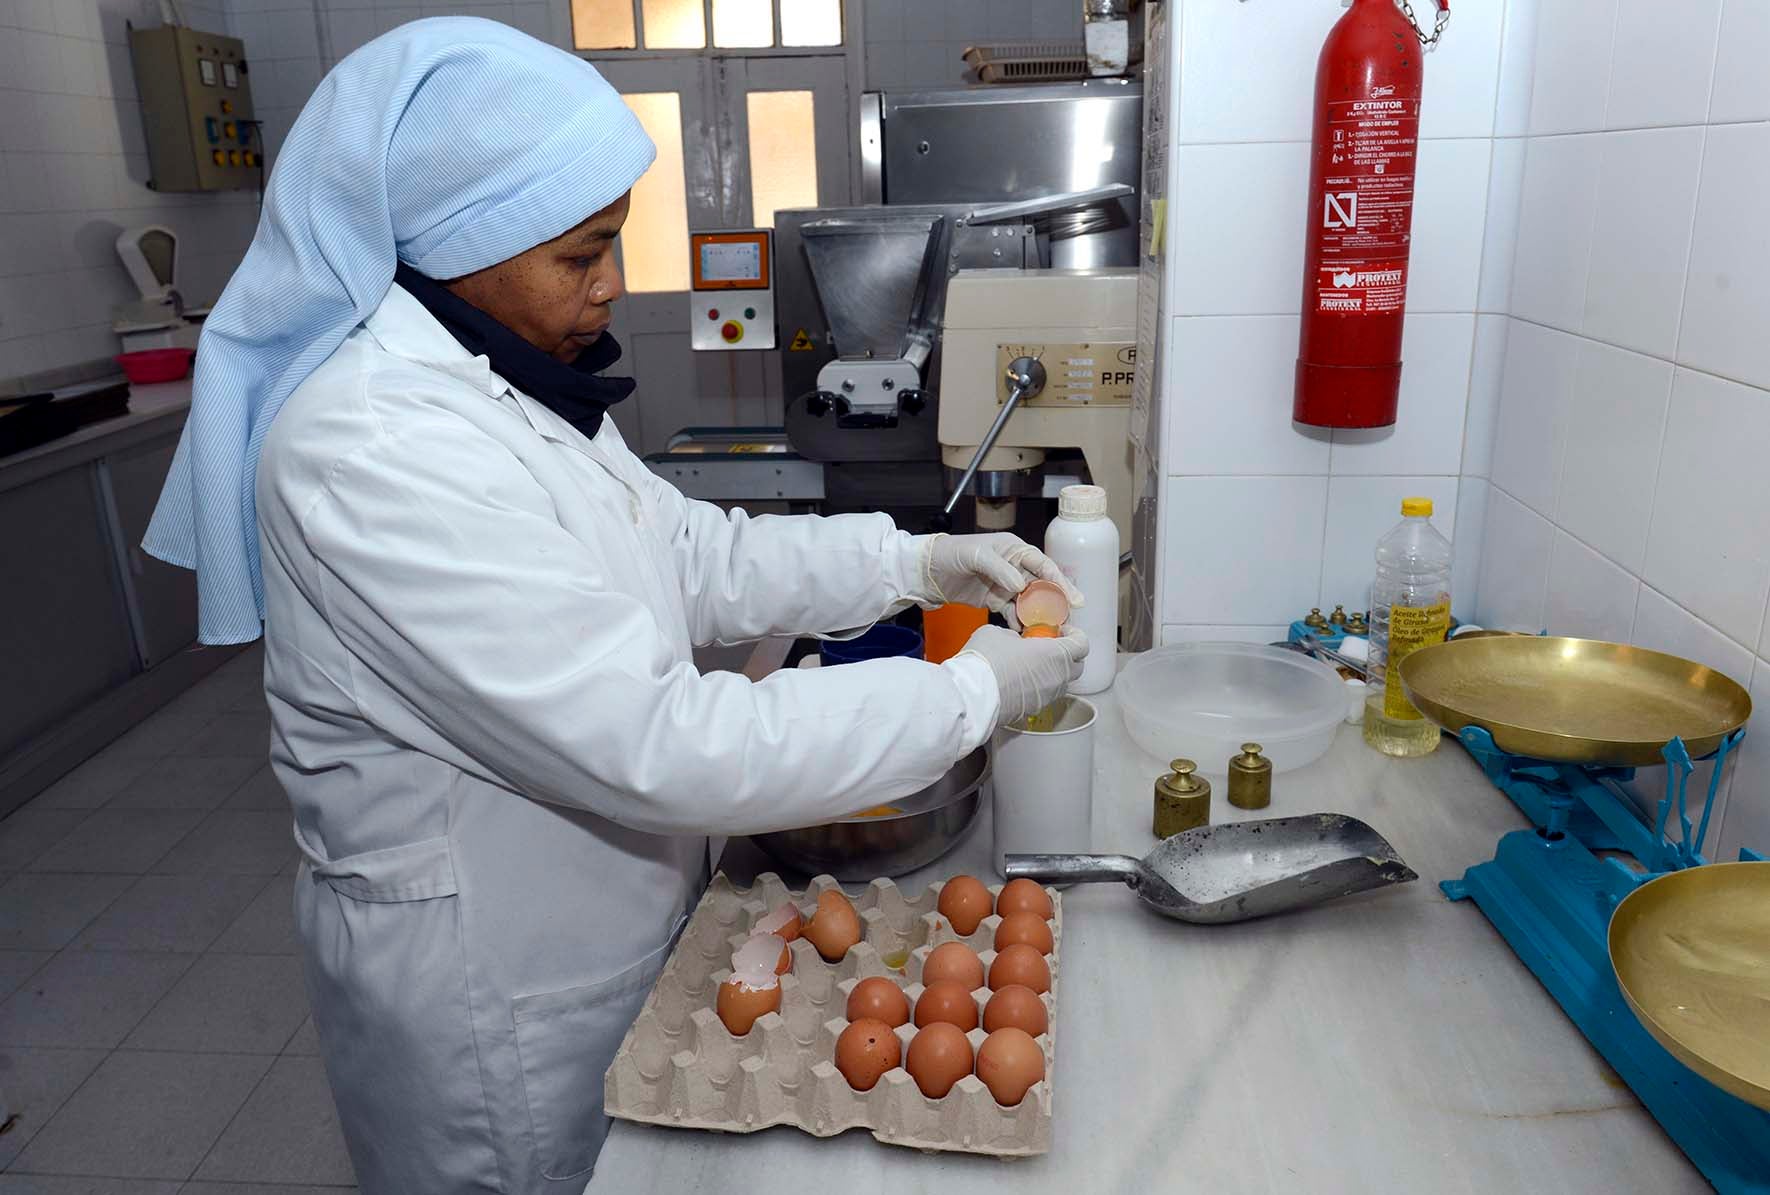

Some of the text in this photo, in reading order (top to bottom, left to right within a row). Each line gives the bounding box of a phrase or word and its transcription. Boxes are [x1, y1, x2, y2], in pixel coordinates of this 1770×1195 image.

[1353, 101, 1402, 110] EXTINTOR
[1356, 270, 1402, 283] PROTEXT
[1394, 610, 1416, 618] Aceite
